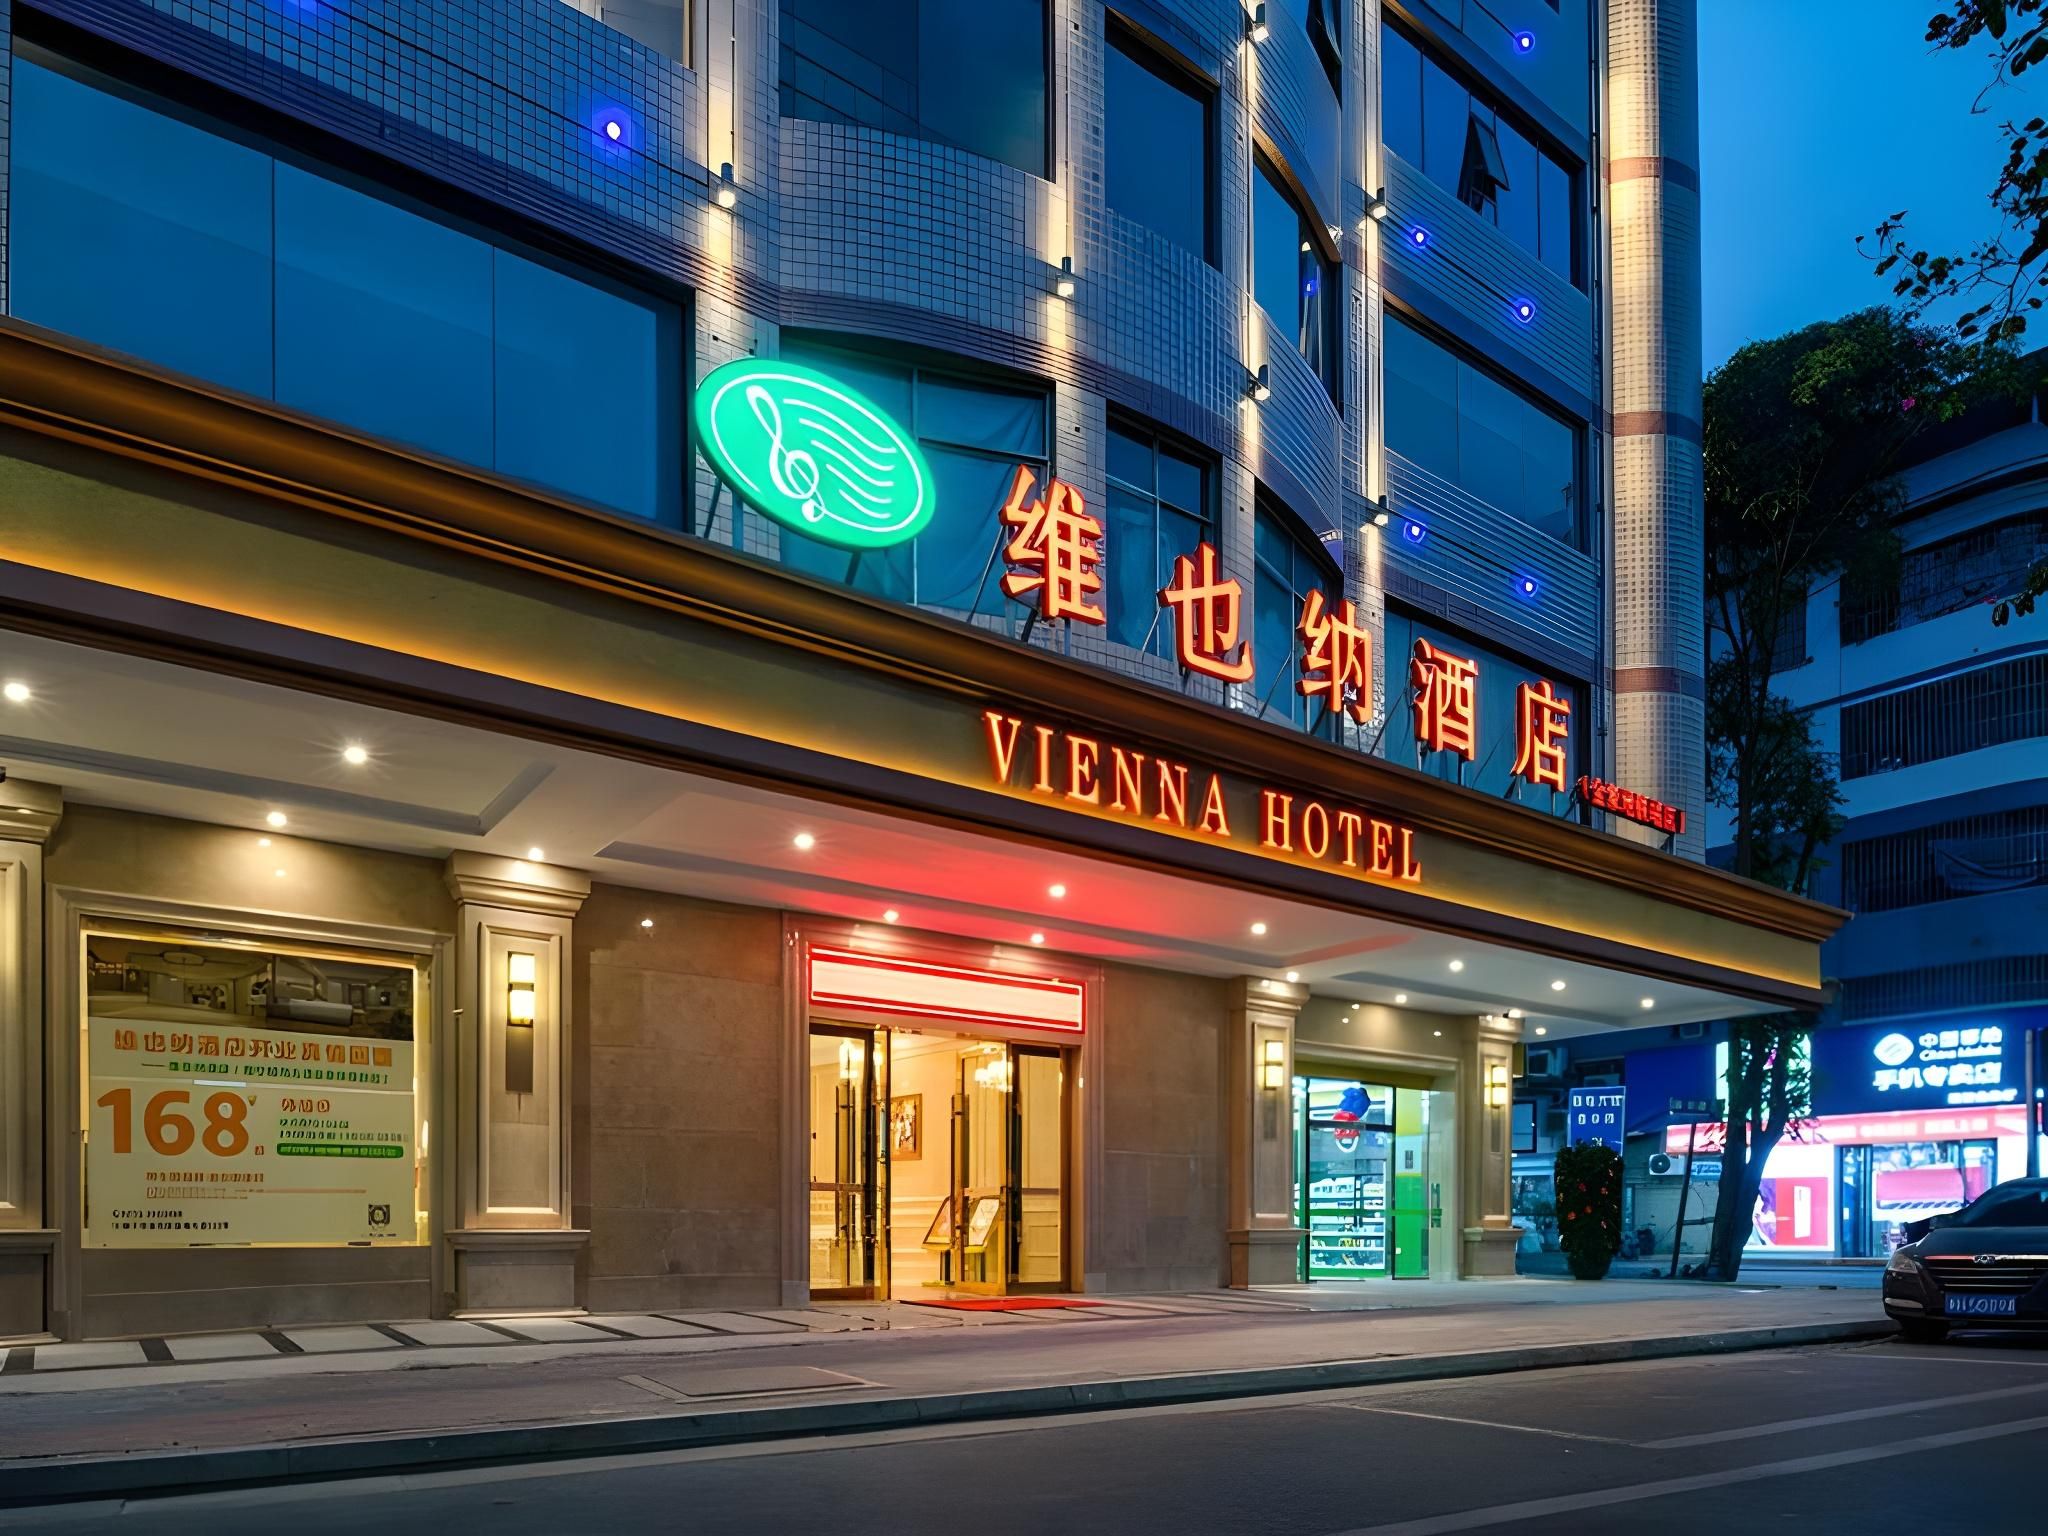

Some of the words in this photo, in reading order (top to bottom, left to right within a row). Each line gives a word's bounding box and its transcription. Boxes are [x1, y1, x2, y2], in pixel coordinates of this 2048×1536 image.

[999, 464, 1572, 792] 维也纳酒店
[984, 711, 1231, 837] VIENNA
[1262, 790, 1422, 883] HOTEL
[97, 1088, 249, 1157] 168
